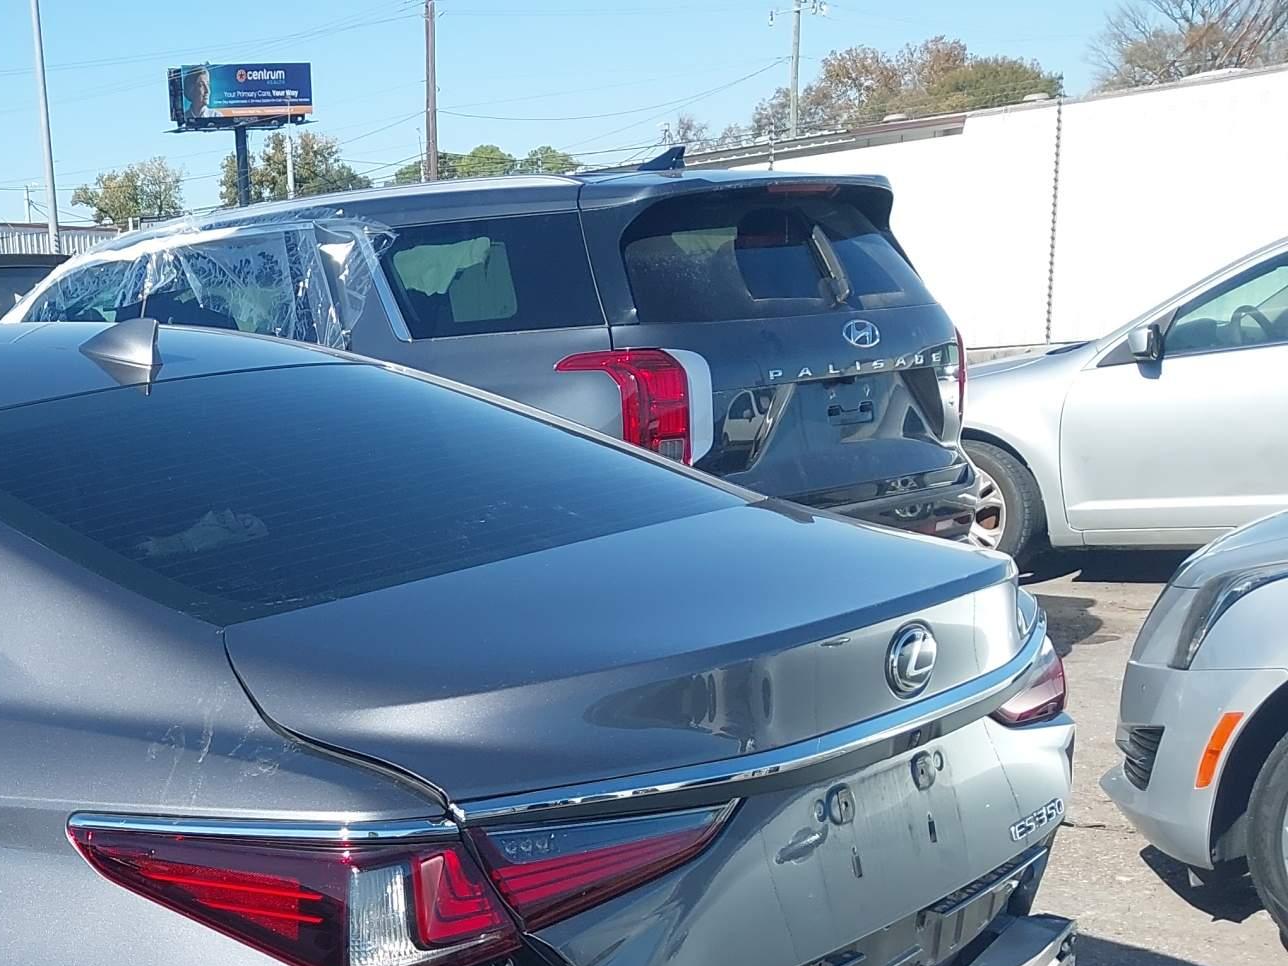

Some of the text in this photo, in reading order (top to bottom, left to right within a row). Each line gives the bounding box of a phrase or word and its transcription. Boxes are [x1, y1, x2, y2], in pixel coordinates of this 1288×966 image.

[247, 69, 285, 80] centrum
[237, 90, 257, 98] Primary
[285, 89, 298, 97] Way
[768, 351, 943, 381] PALISADE
